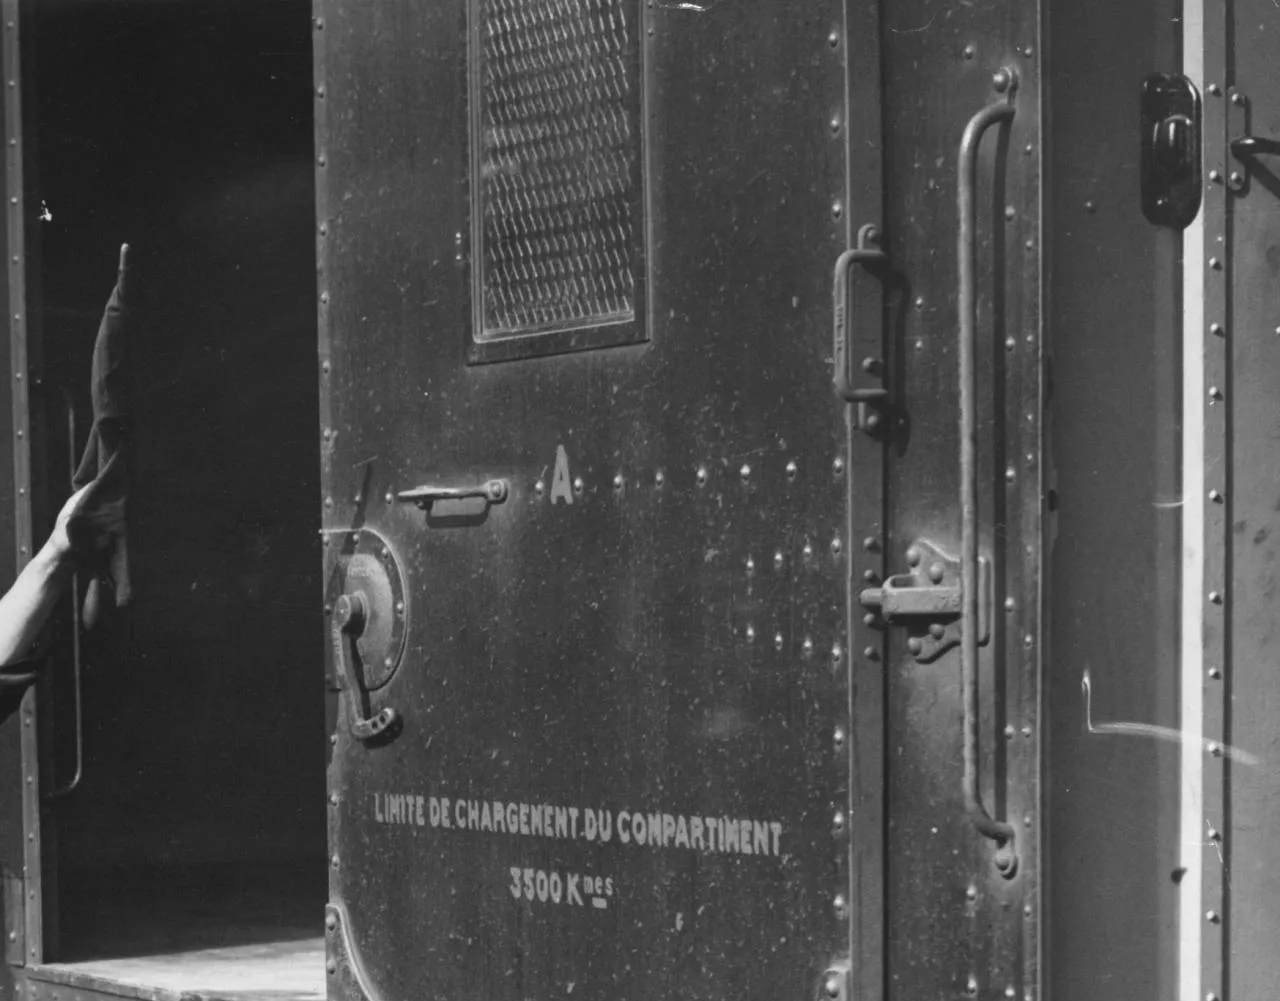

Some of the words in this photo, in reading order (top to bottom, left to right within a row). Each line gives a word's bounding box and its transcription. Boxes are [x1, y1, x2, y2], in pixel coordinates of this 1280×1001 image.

[551, 443, 574, 506] A
[374, 791, 426, 827] LIMITE
[429, 796, 451, 829] DE
[455, 797, 579, 840] CHARGEMENT
[584, 807, 612, 842] DU
[617, 810, 782, 857] COMPARTIMENT
[509, 866, 563, 904] 3500
